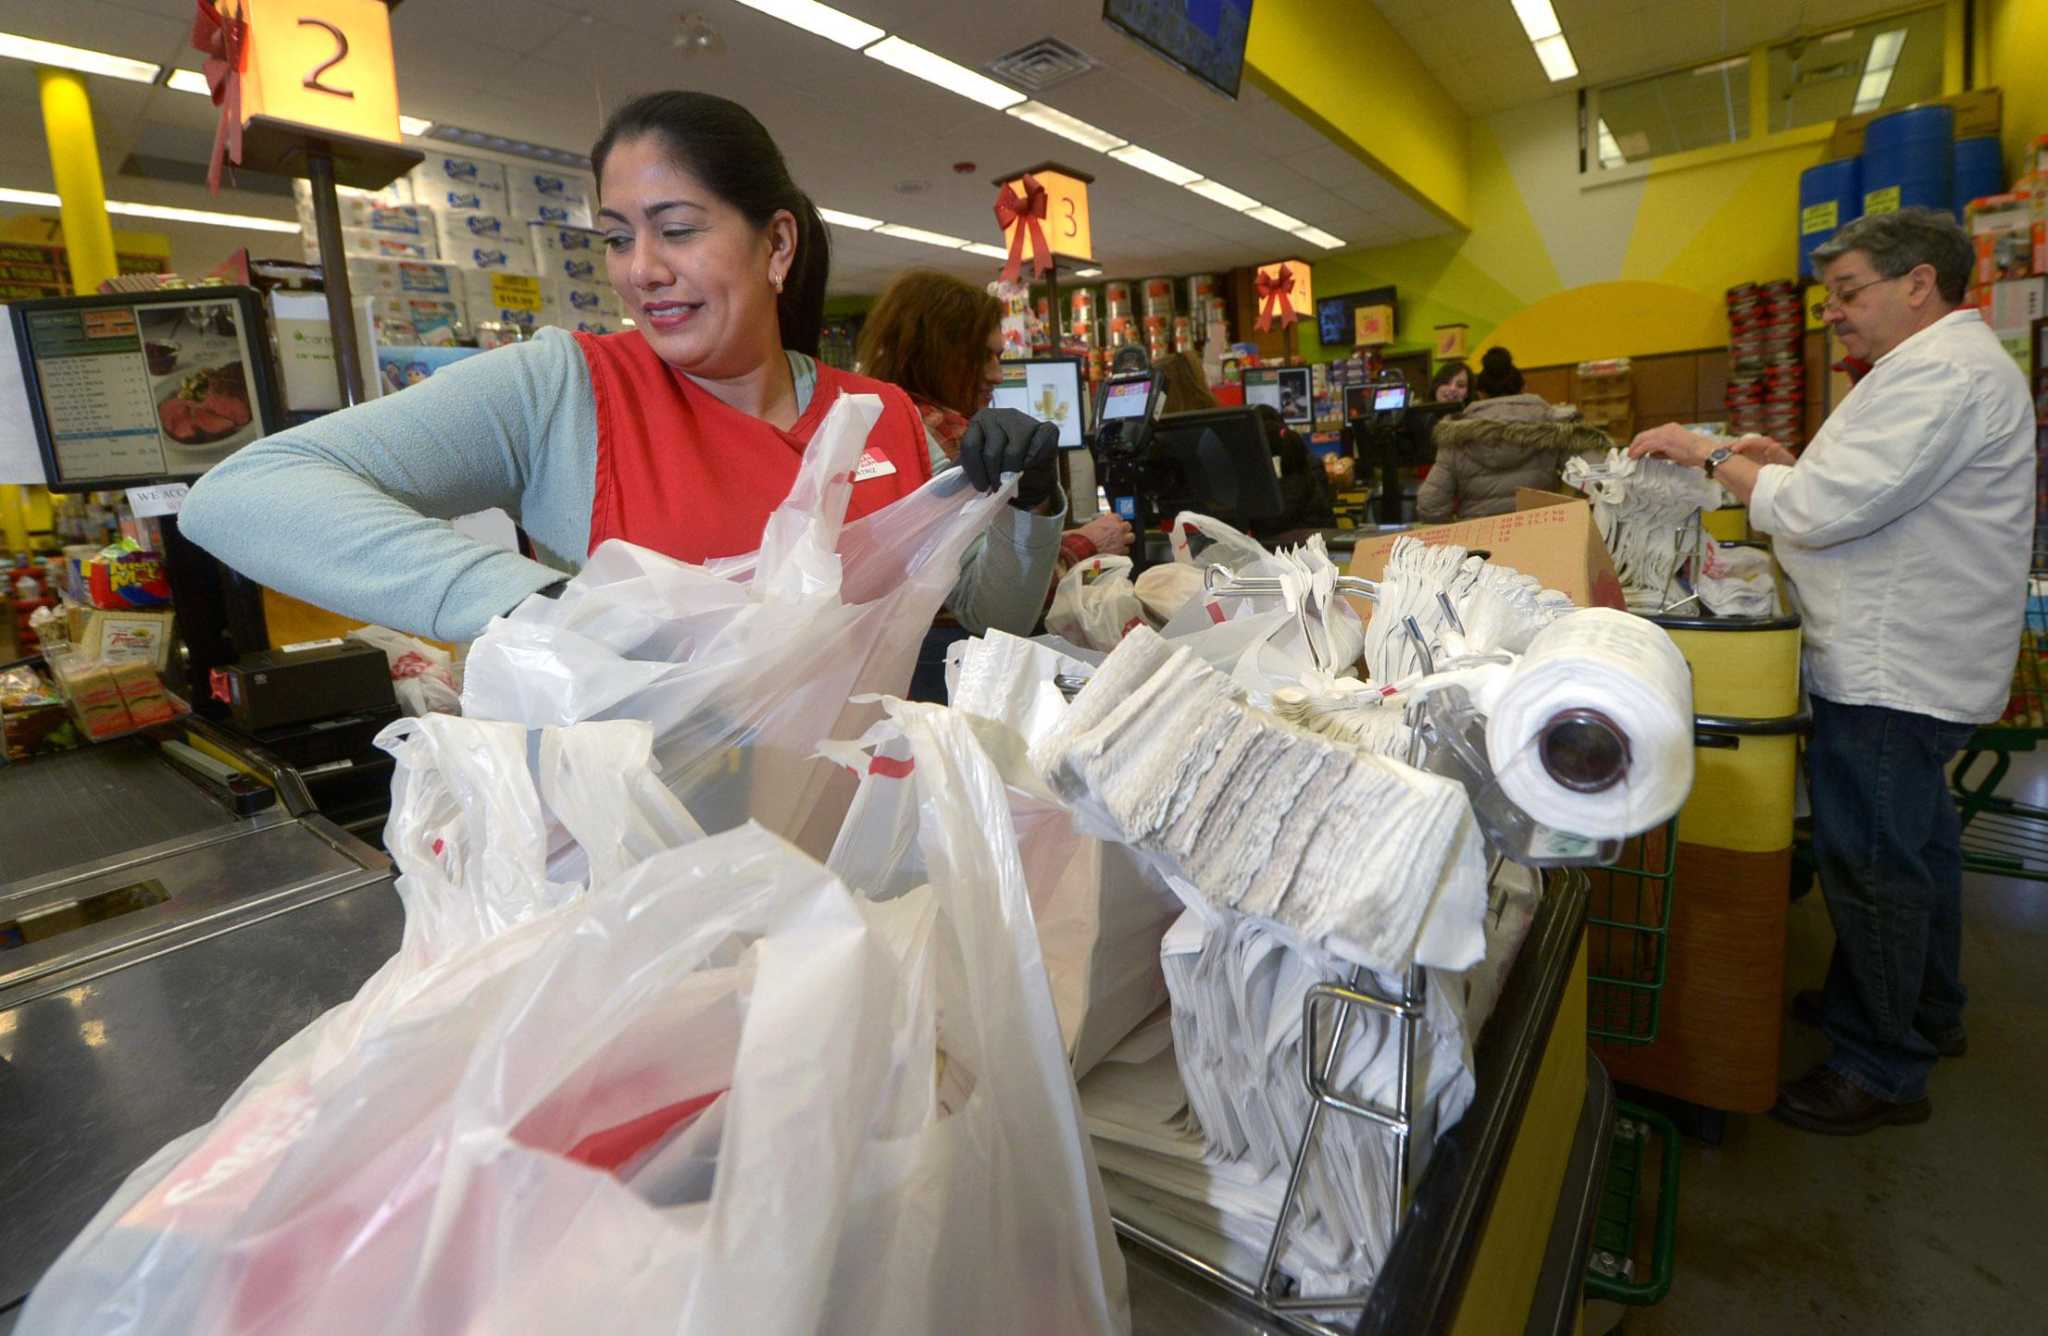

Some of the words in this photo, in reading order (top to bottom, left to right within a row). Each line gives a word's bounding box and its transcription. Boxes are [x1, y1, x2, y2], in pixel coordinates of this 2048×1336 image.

[297, 18, 354, 98] 2
[1062, 196, 1077, 237] 3
[136, 489, 160, 501] WE
